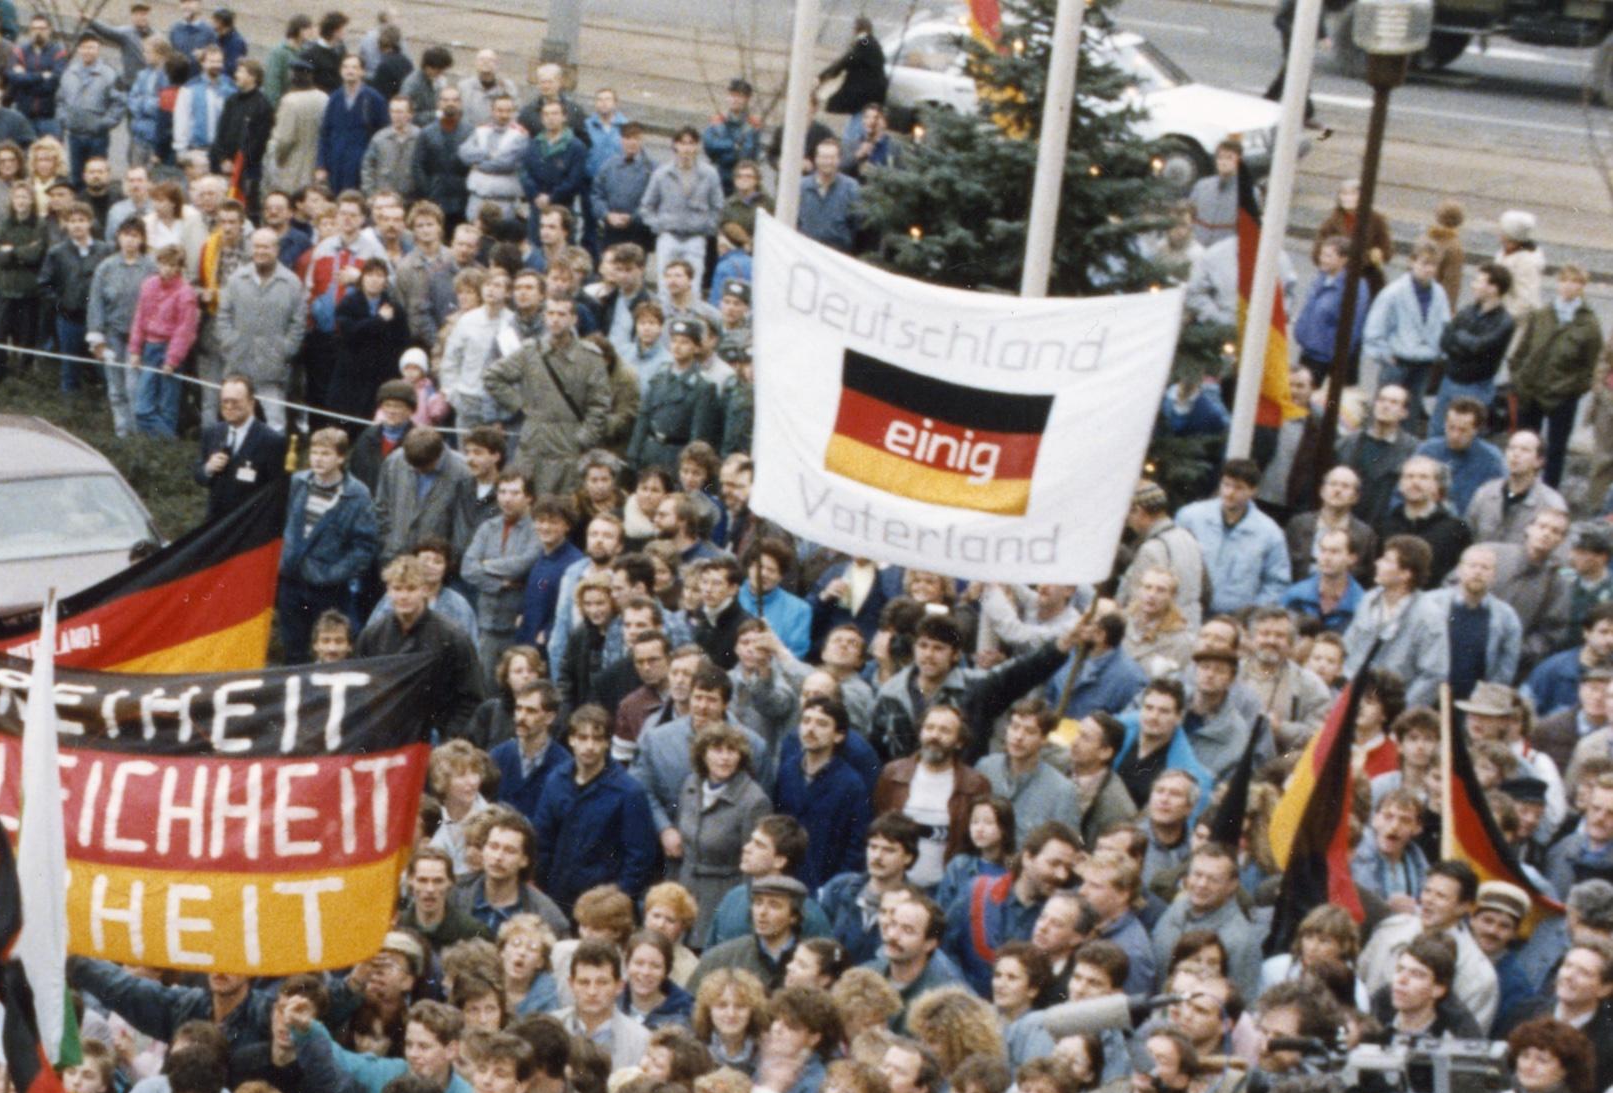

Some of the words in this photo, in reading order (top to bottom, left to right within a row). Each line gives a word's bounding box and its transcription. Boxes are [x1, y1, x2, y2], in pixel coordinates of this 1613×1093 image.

[787, 262, 1109, 372] Deutschland
[884, 418, 1000, 485] einig
[798, 471, 1060, 564] Vaterland
